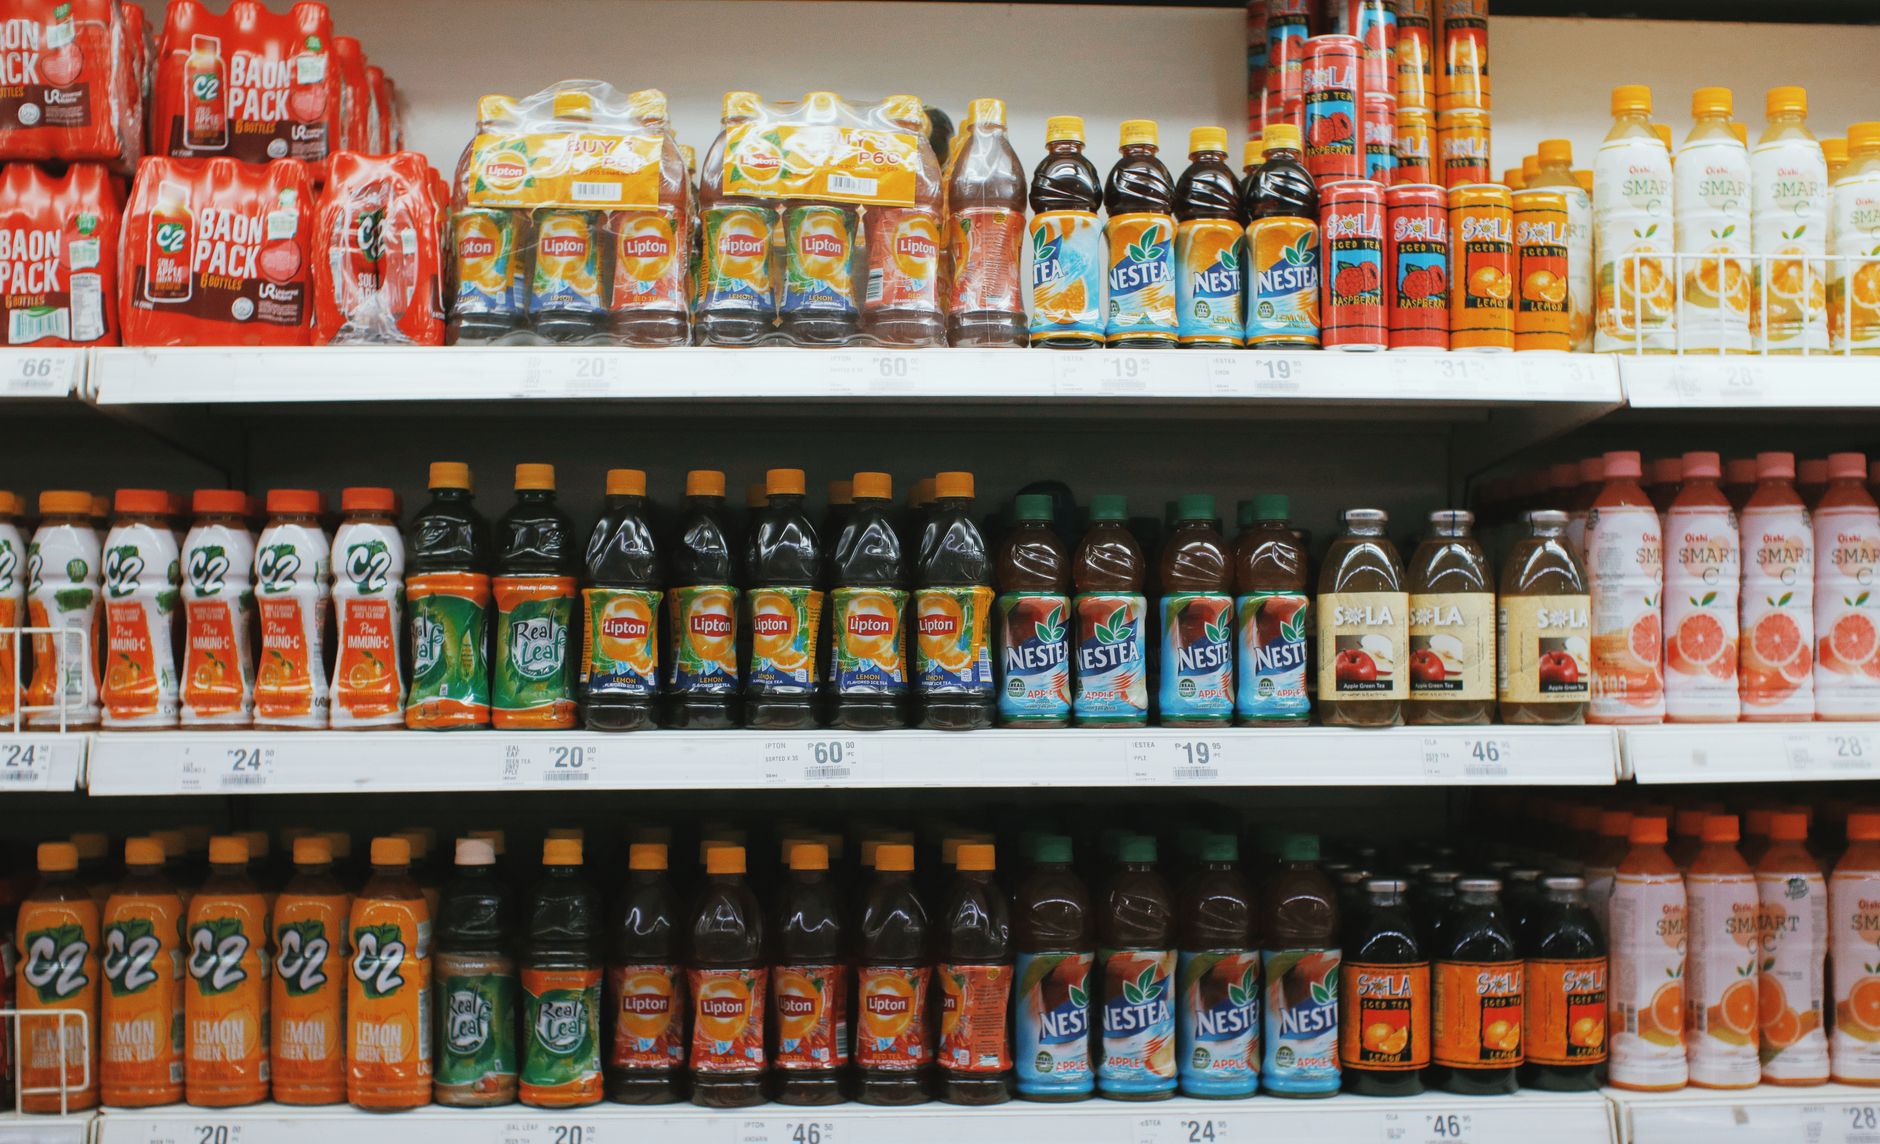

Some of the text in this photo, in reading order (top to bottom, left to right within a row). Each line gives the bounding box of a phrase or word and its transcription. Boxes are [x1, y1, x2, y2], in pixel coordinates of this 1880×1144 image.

[229, 55, 292, 89] BAON
[193, 75, 220, 99] C2
[1333, 91, 1353, 101] TEA
[228, 86, 290, 122] PACK
[235, 121, 276, 134] 6 BOTTLES
[567, 139, 616, 154] BUY
[488, 164, 524, 178] Lipton
[199, 207, 263, 245] BAON
[0, 229, 61, 262] BAON
[156, 223, 187, 252] C2
[722, 237, 761, 253] Lipton
[804, 238, 841, 253] Lipton
[900, 238, 935, 254] Lipton
[1333, 240, 1381, 250] ICED TEA
[543, 239, 584, 255] Lipton
[627, 239, 667, 256] Lipton
[1400, 243, 1446, 254] ICED TEA
[1468, 243, 1496, 253] ICED
[1522, 247, 1550, 257] ICED
[194, 239, 261, 279] PACK
[0, 258, 60, 295] PACK
[200, 273, 243, 291] 6 BOTTLES
[1258, 266, 1317, 294] NESTEA
[5, 293, 45, 309] 6 BOTTLES
[1332, 295, 1381, 307] RASPBERRY
[1400, 298, 1446, 310] RASPBERRY
[1476, 297, 1509, 309] LEMON
[1530, 301, 1563, 312] LEMON
[1276, 313, 1307, 323] LEMON
[22, 357, 51, 377] 66
[576, 356, 605, 378] 20
[879, 356, 908, 378] 60
[1112, 357, 1138, 377] 19
[1264, 359, 1291, 379] 19
[1684, 532, 1709, 543] Oishi
[1763, 532, 1785, 543] Oishi
[1837, 532, 1862, 543] Oishi
[106, 550, 144, 594] C2
[188, 550, 229, 594] C2
[258, 549, 301, 591] C2
[346, 545, 391, 591] C2
[266, 621, 286, 634] Plus
[359, 621, 378, 634] Plus
[513, 607, 557, 648] Real
[603, 617, 646, 636] Lipton
[693, 617, 731, 634] Lipton
[754, 618, 788, 632] Lipton
[850, 617, 890, 633] Lipton
[919, 617, 954, 632] Lipton
[347, 635, 390, 650] IMMUNO-C
[521, 625, 568, 666] Leaf
[612, 676, 637, 684] LEMON
[6, 744, 35, 767] 24
[814, 741, 855, 764] 60 00
[1182, 742, 1222, 764] 19 95
[1472, 741, 1500, 761] 46
[1834, 736, 1862, 757] 28
[232, 748, 261, 771] 24
[554, 746, 596, 768] 20 00
[24, 935, 89, 997] C2
[104, 928, 160, 991] C2
[189, 927, 249, 991] C2
[276, 930, 329, 991] C2
[352, 932, 405, 995] C2
[624, 997, 668, 1011] Lipton
[703, 999, 743, 1015] Lipton
[868, 998, 906, 1013] Lipton
[1363, 1000, 1410, 1009] ICED TEA
[1484, 999, 1507, 1008] ICED
[193, 1019, 245, 1044] LEMON
[281, 1019, 325, 1045] LEMON
[356, 1022, 402, 1046] LEMON
[226, 1045, 245, 1062] TEA
[307, 1045, 326, 1062] TEA
[384, 1046, 402, 1064] TEA
[1108, 1056, 1140, 1067] APPLE
[1297, 1058, 1328, 1067] APPLE
[1368, 1052, 1401, 1062] LEMON
[1489, 1050, 1517, 1060] LEMON
[1055, 1060, 1086, 1071] APPLE
[1434, 1115, 1461, 1137] 46
[1849, 1107, 1877, 1129] 28
[201, 1124, 228, 1144] 20
[555, 1125, 582, 1144] 20
[792, 1123, 820, 1144] 46
[1187, 1120, 1216, 1143] 24
